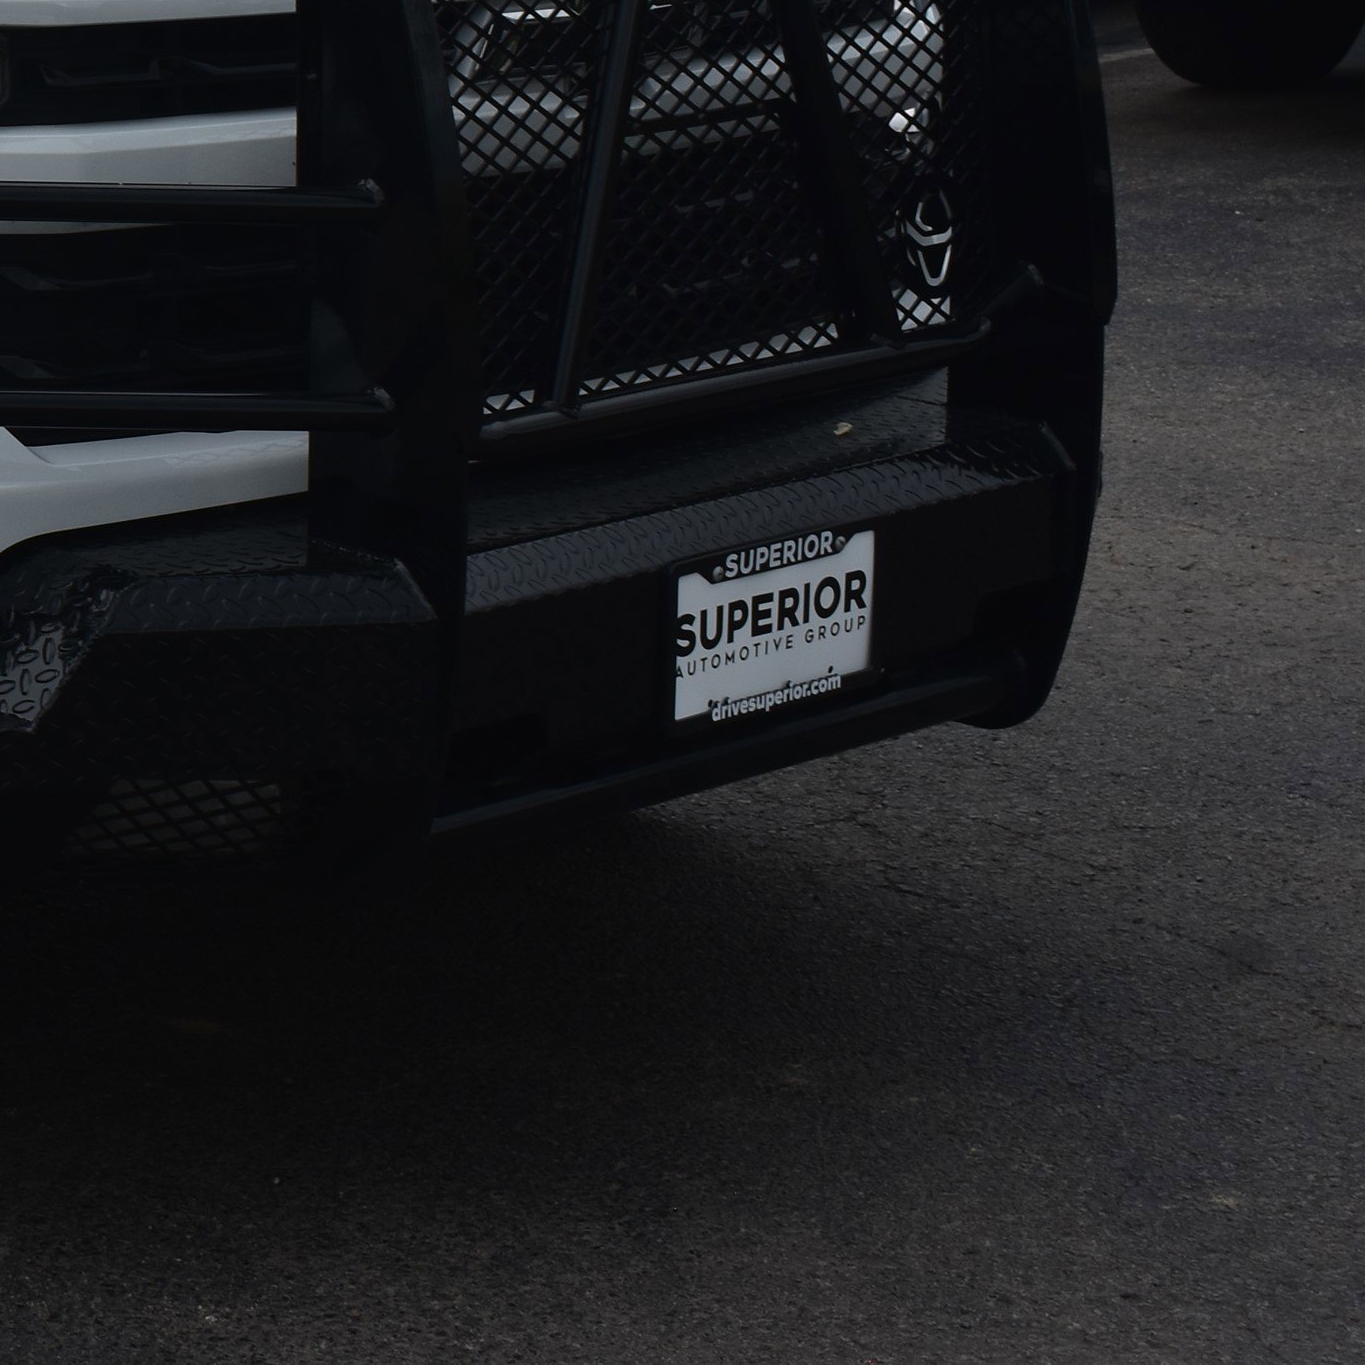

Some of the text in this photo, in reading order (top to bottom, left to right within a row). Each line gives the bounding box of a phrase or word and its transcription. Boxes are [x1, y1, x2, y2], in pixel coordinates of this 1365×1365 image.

[725, 531, 833, 578] SUPERIOR
[676, 570, 867, 657] SUPERIOR
[675, 615, 866, 678] AUTOMOTIVE GROUP
[711, 673, 841, 721] drivesuperior.com
